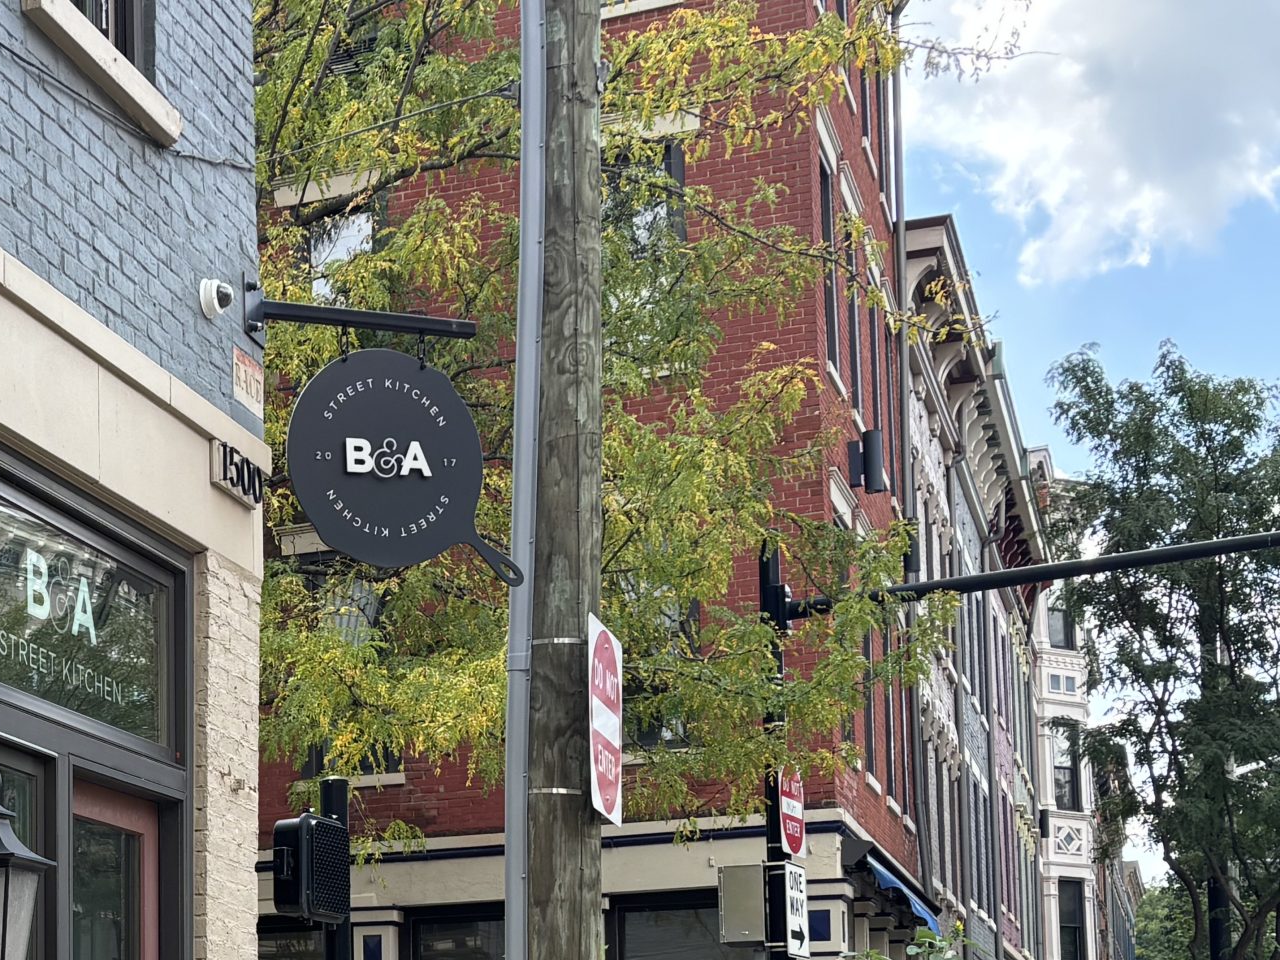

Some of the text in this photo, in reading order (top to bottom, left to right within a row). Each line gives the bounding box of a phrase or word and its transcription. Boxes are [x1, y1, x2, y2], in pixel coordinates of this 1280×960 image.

[323, 377, 447, 427] STREET KITCHEN
[220, 441, 263, 504] 1500
[315, 451, 332, 461] 20
[345, 437, 433, 478] B&A
[326, 489, 449, 537] STREET KITCHEN
[62, 659, 123, 706] KITCHEN
[593, 657, 618, 704] DO NOT
[598, 744, 616, 783] ENTER
[786, 819, 801, 838] ENTER
[788, 870, 803, 894] ONE
[790, 895, 805, 920] WAY
